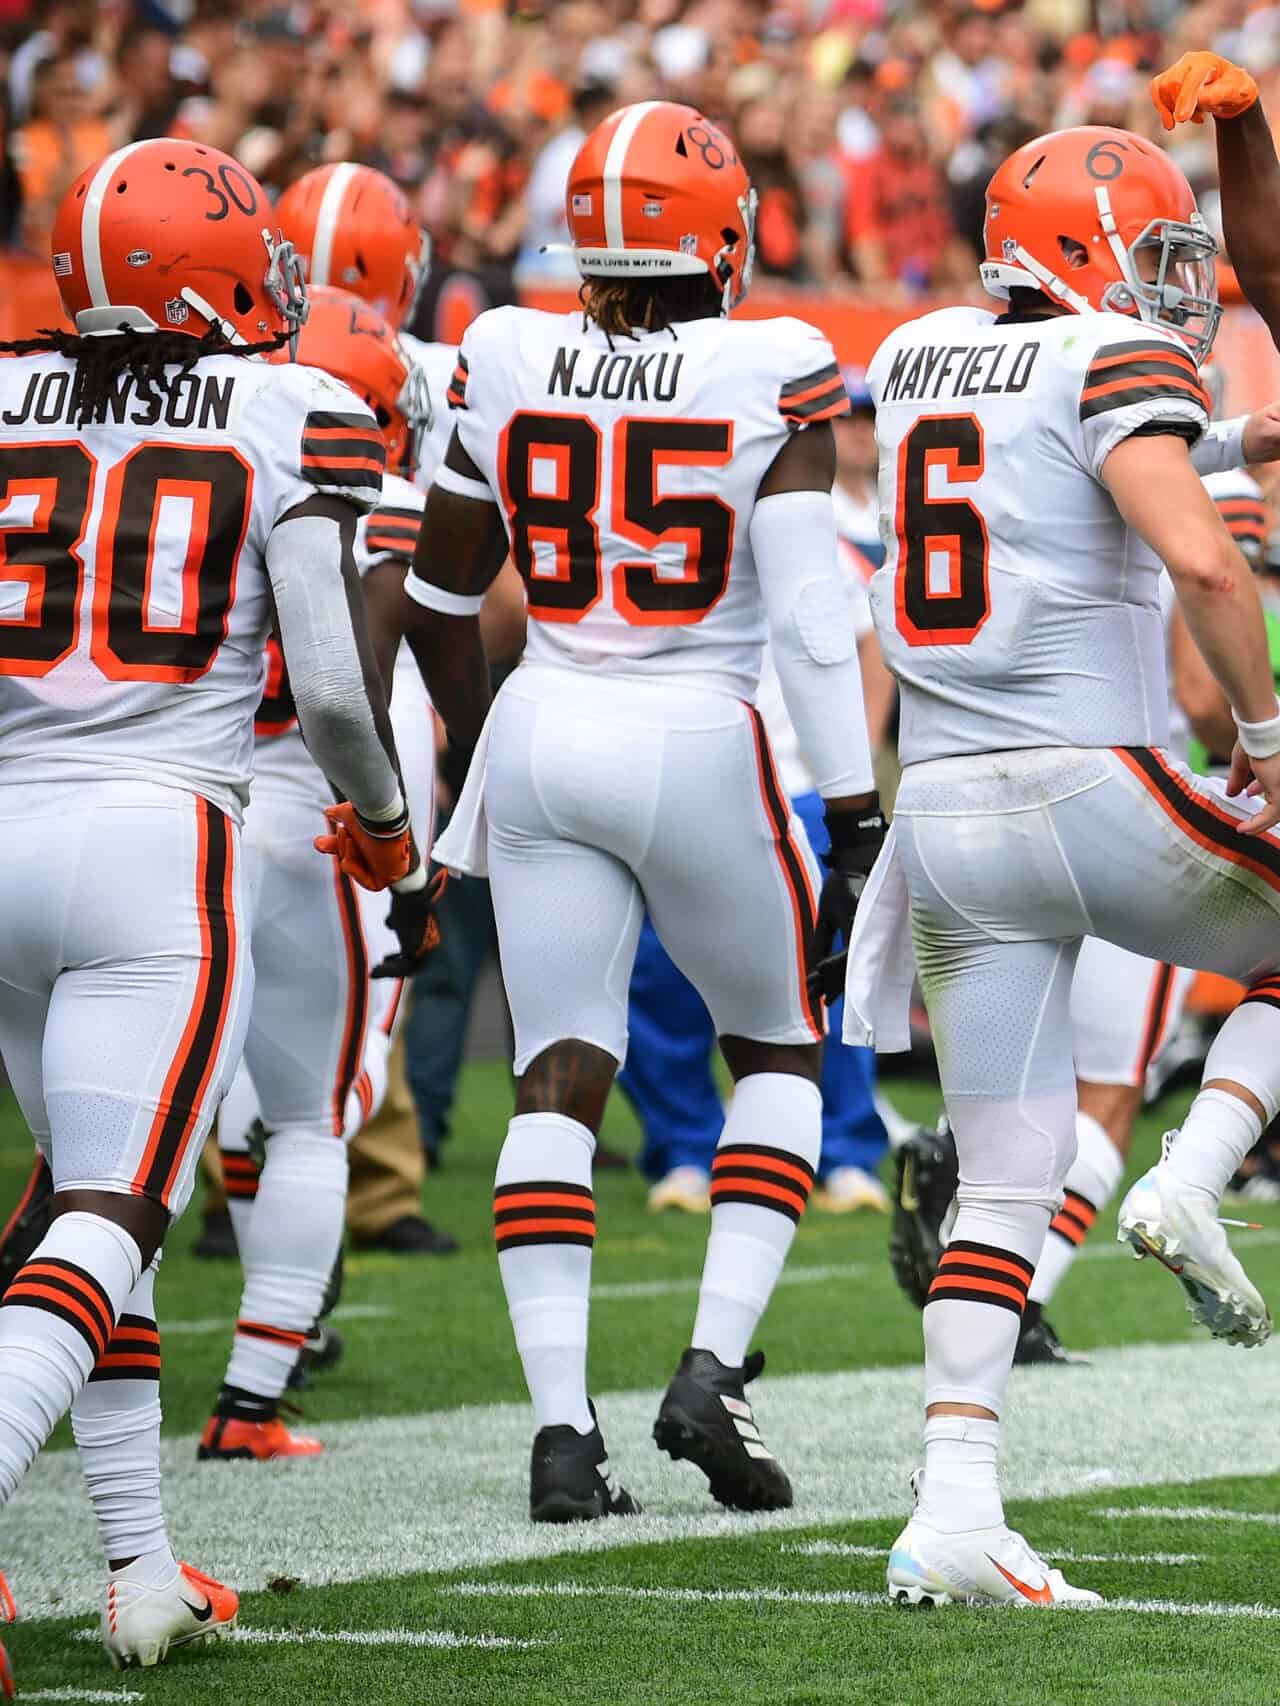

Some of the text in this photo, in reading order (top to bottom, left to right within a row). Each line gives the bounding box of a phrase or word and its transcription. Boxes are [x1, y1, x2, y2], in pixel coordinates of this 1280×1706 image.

[1086, 140, 1128, 181] 6
[182, 164, 257, 221] 30
[633, 259, 672, 268] MATTER
[547, 346, 684, 402] NJOKU
[881, 341, 1041, 402] MAYFIELD
[496, 409, 736, 627] 85
[894, 412, 992, 647] 6
[0, 439, 255, 684] 30
